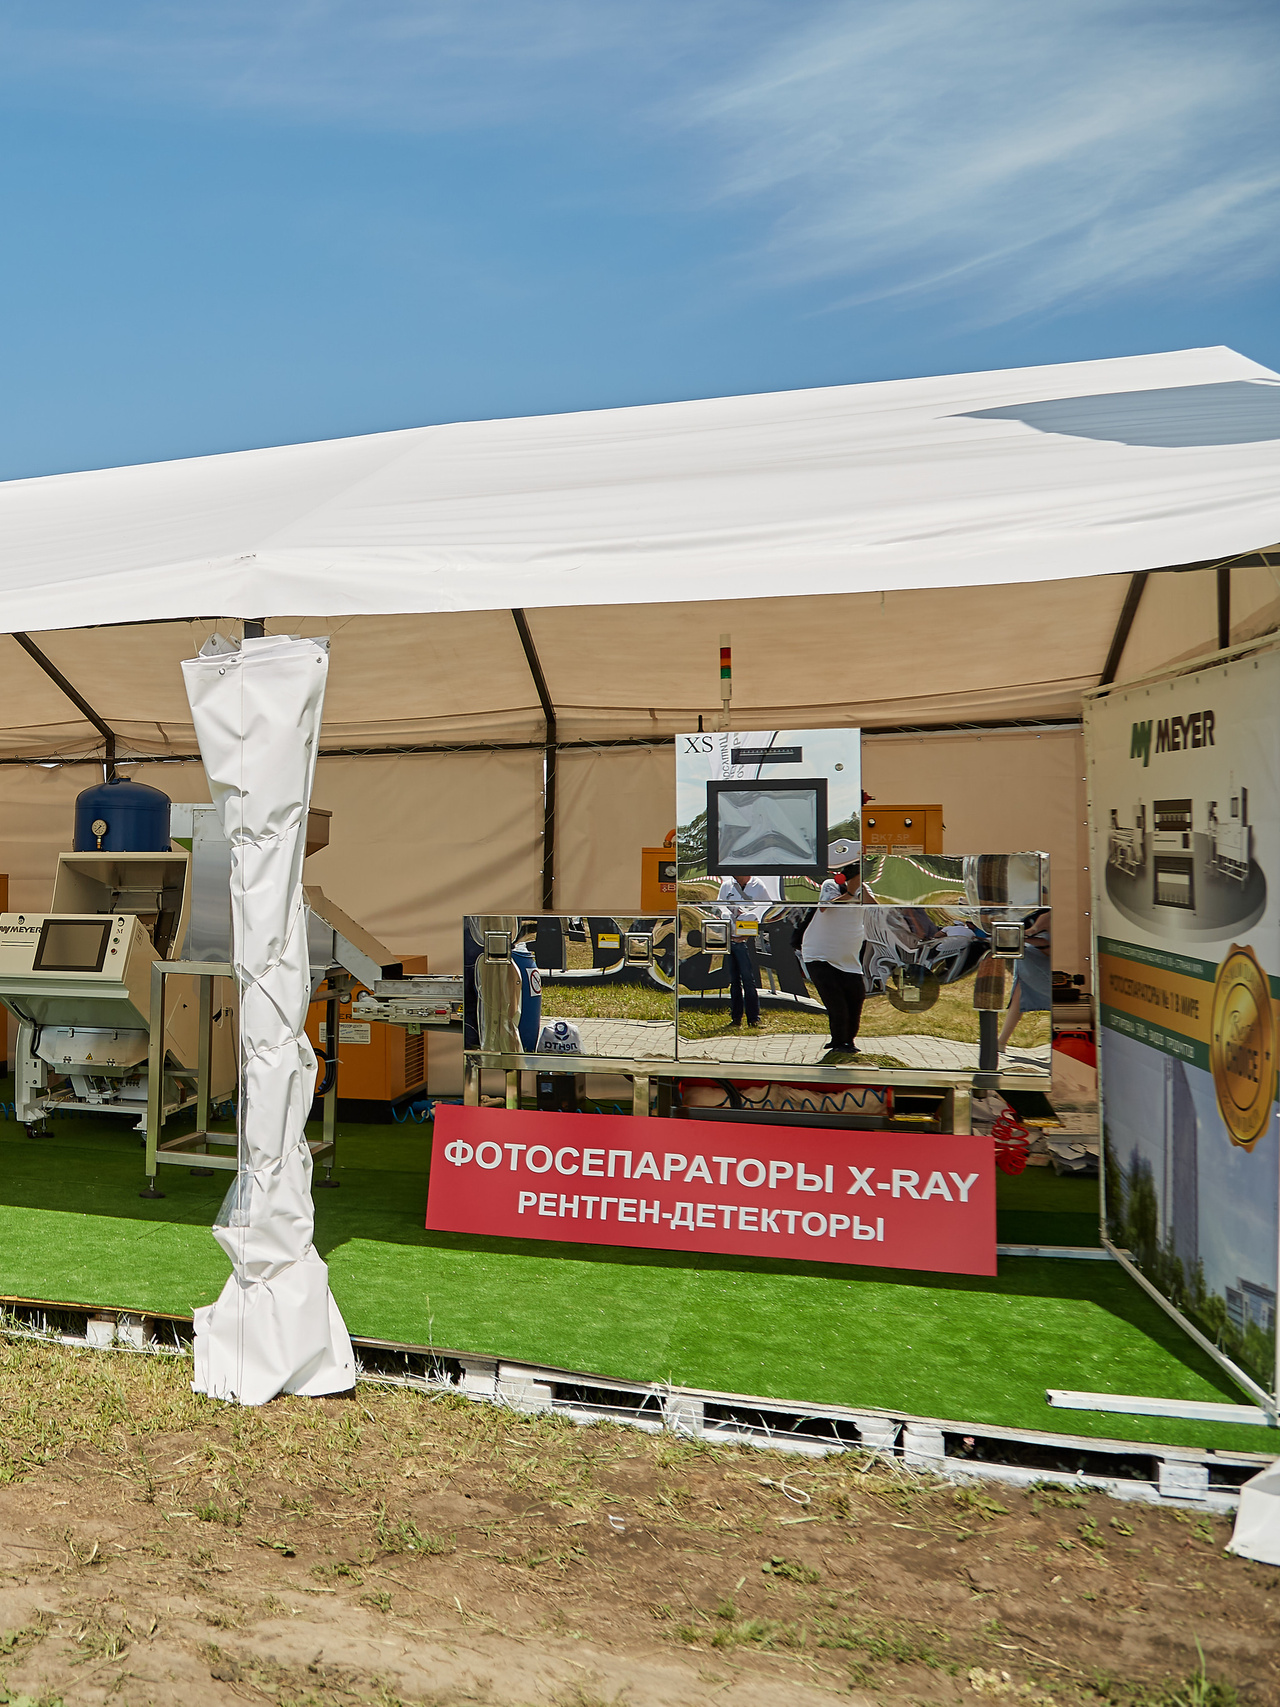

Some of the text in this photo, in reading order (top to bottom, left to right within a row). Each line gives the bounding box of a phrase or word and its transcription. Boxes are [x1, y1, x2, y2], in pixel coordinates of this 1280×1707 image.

[684, 735, 713, 754] XS
[1155, 710, 1215, 753] MEYER
[444, 1139, 979, 1202] ФОТОСЕПАРАТОРЫ X-RAY
[517, 1191, 884, 1241] РЕНТГЕН-ДЕТЕКТОРЫ
